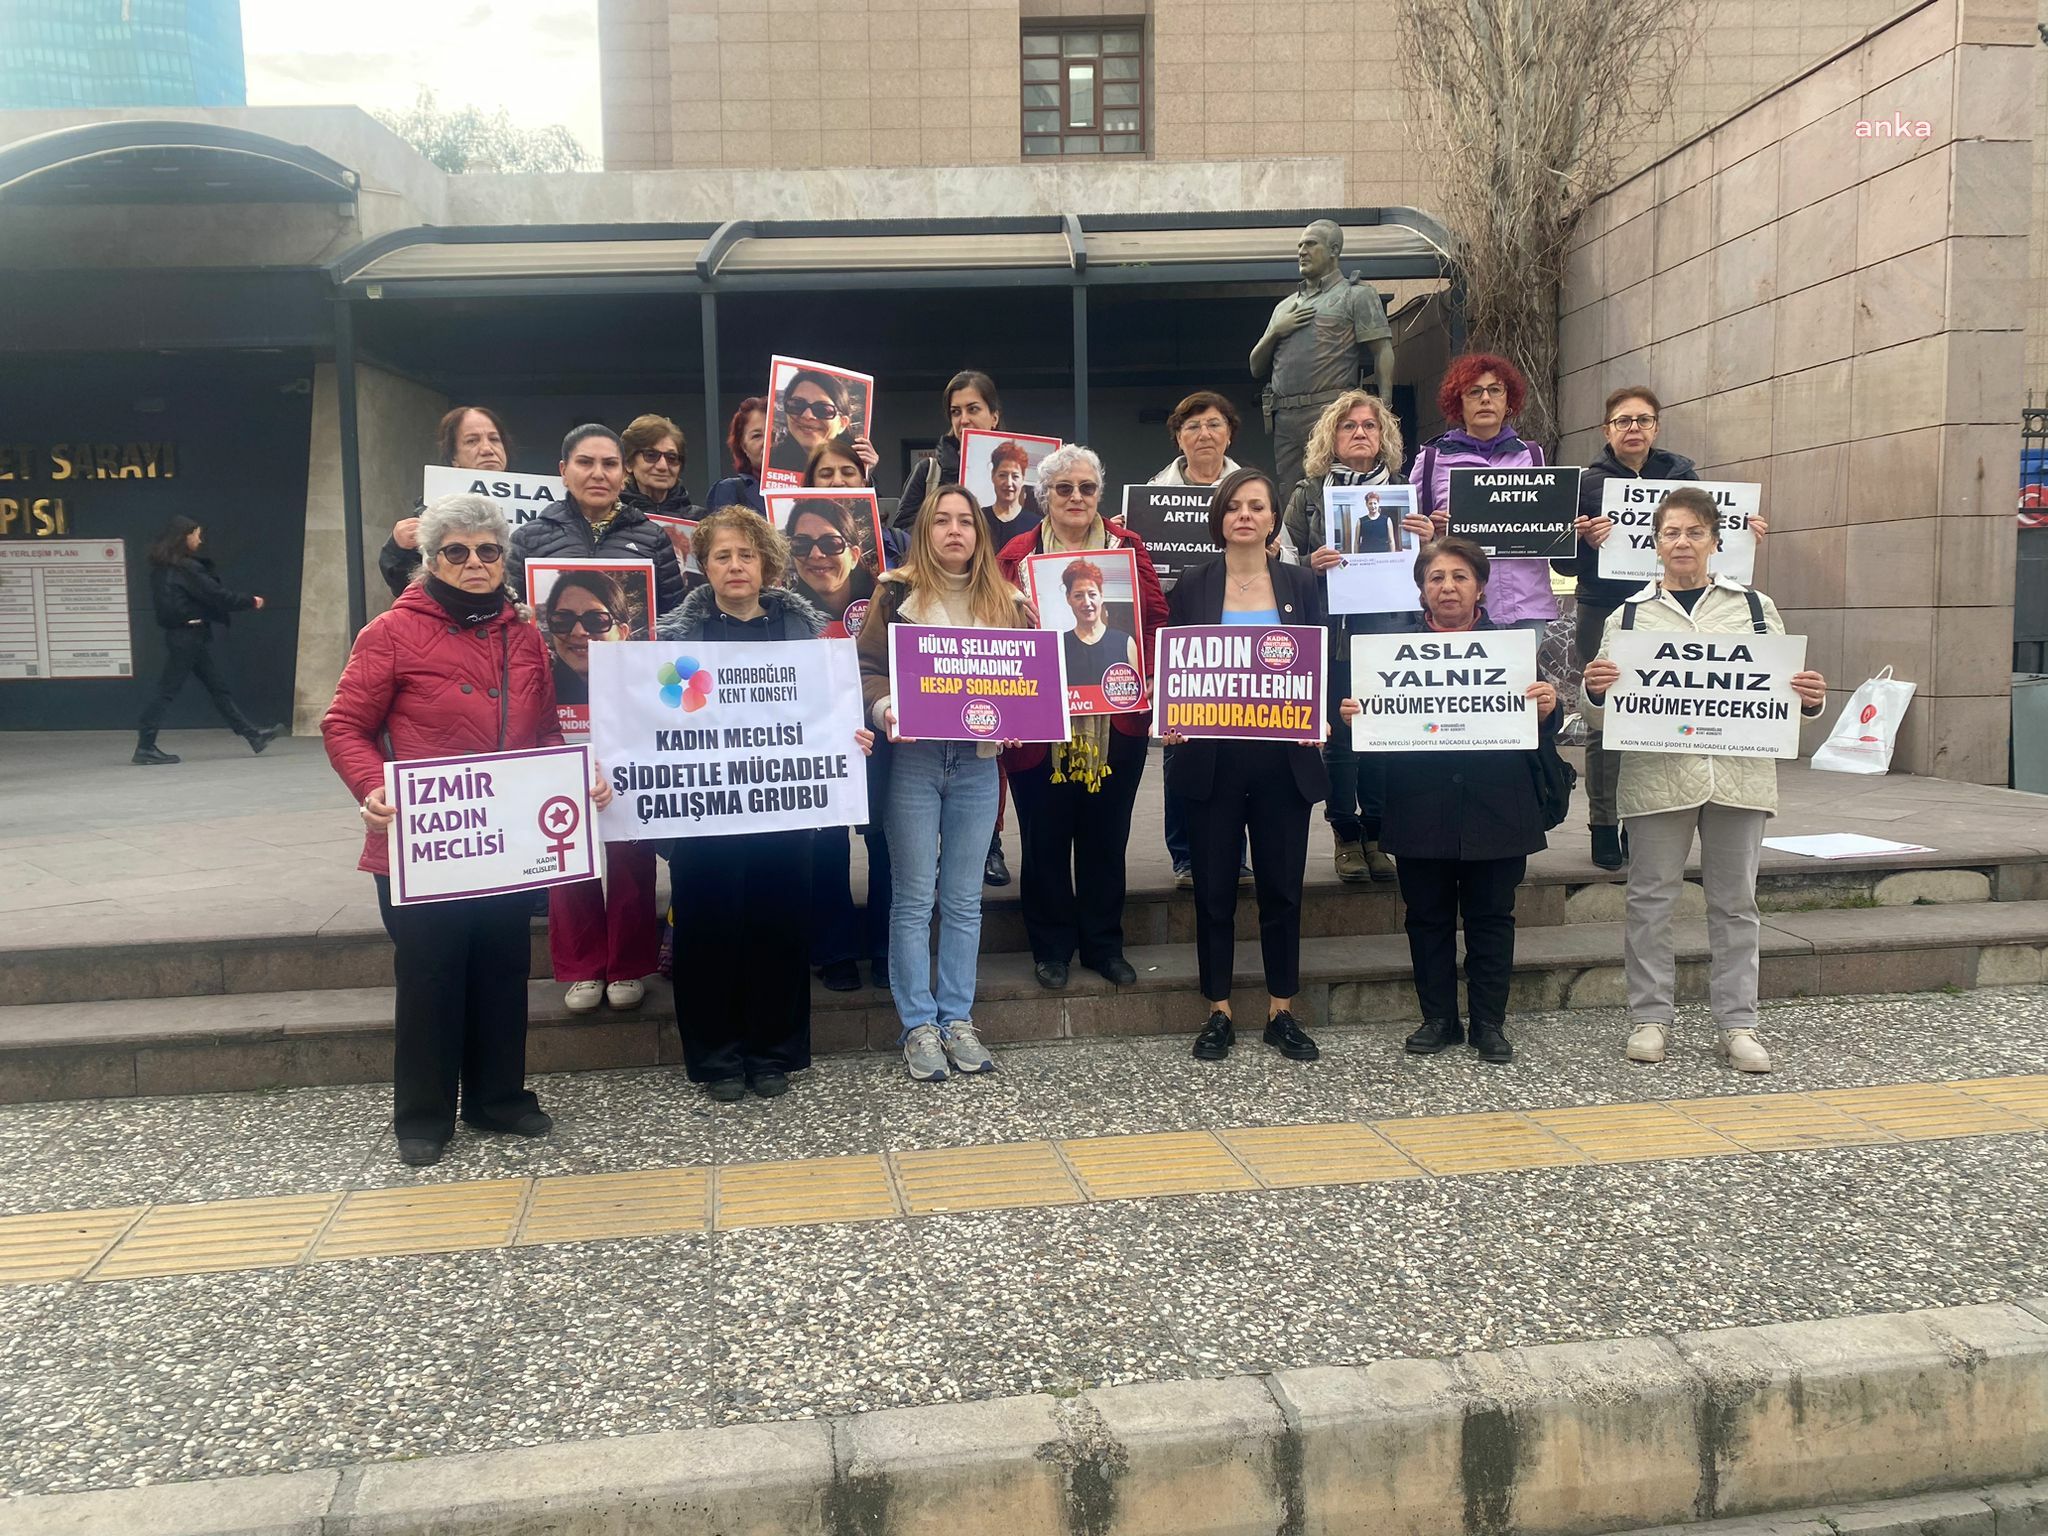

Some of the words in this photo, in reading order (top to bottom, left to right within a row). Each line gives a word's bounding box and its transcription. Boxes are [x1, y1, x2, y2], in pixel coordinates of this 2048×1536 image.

[51, 443, 176, 479] SARAYI
[766, 471, 798, 483] SERPİL
[1474, 474, 1555, 486] KADINLAR
[468, 480, 555, 502] ASLA
[1489, 491, 1538, 502] ARTIK
[1452, 523, 1564, 533] SUSMAYACAKLAR
[918, 634, 958, 655] HÜLYA
[961, 639, 1036, 658] ŞELLAVCI'YI
[1169, 636, 1251, 669] KADIN
[1394, 642, 1488, 661] ASLA
[1654, 642, 1753, 662] ASLA
[717, 664, 796, 685] KARABAĞLAR
[934, 657, 1023, 677] KORUMADINIZ
[1377, 668, 1507, 688] YALNIZ
[920, 676, 963, 695] HESAP
[966, 677, 1039, 697] SORACAĞIZ
[1167, 670, 1313, 700] CİNAYETLERİNİ
[1635, 669, 1771, 691] YALNIZ
[719, 687, 746, 704] KENT
[750, 683, 798, 703] KONSEYİ
[1359, 691, 1526, 715] YÜRÜMEYECEKSİN
[557, 706, 577, 718] PİL
[1068, 701, 1093, 711] AVCI
[1167, 700, 1313, 730] DURDURACAĞIZ
[1613, 692, 1788, 720] YÜRÜMEYECEKSİN
[656, 729, 719, 751] KADIN
[724, 722, 804, 749] MECLİSİ
[612, 761, 722, 795] ŞİDDETLE
[727, 754, 848, 785] MÜCADELE
[408, 767, 495, 806] İZMİR
[636, 789, 743, 825] ÇALIŞMA
[748, 784, 828, 814] GRUBU
[410, 807, 487, 835] KADIN
[411, 828, 505, 863] MECLİSİ
[536, 856, 557, 865] KADIN
